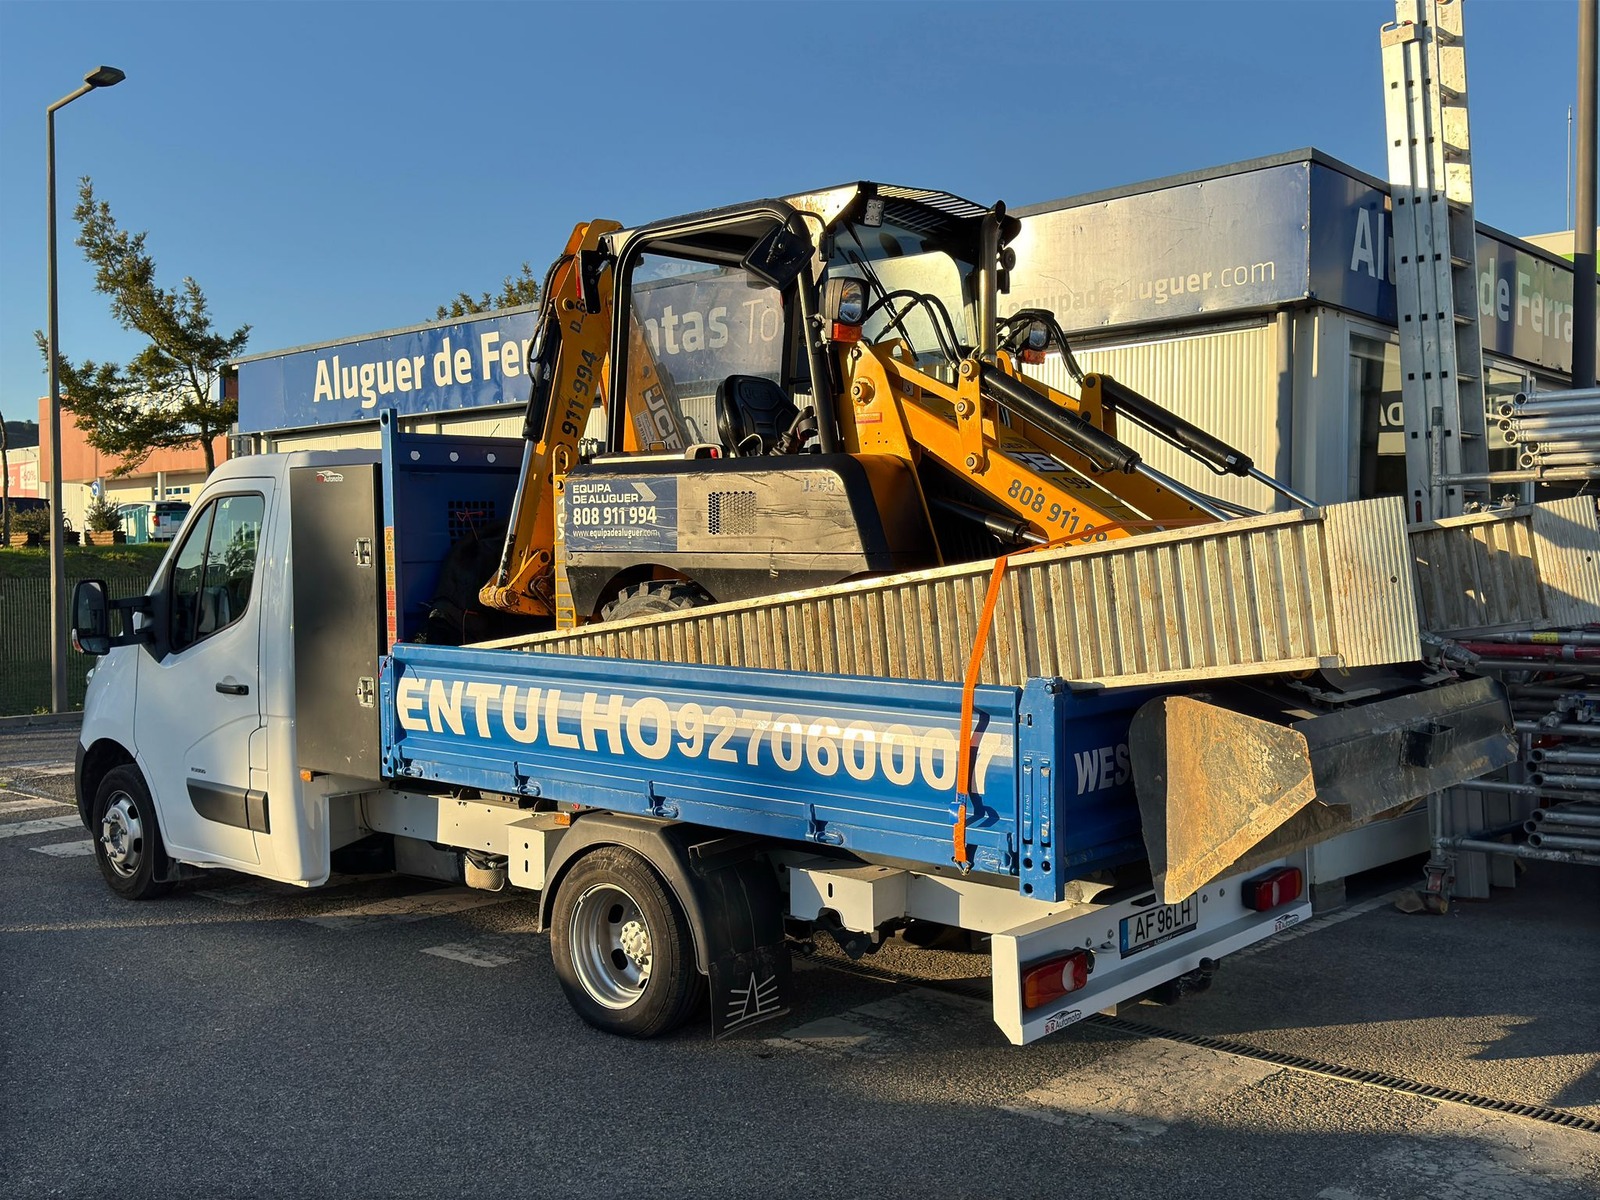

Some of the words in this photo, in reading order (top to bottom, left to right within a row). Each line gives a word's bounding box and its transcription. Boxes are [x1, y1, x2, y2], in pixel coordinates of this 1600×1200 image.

[1479, 258, 1510, 322] de
[313, 355, 425, 409] Aluguer
[433, 337, 472, 387] de
[572, 483, 611, 494] EQUIPA
[573, 507, 599, 525] 808
[603, 506, 626, 525] 911
[629, 505, 657, 525] 994
[1008, 479, 1046, 513] 808
[1046, 503, 1080, 535] 911
[572, 527, 657, 539] www.equipadealuguer.com
[396, 677, 672, 760] ENTULHO
[676, 703, 1001, 795] 927060007
[1074, 743, 1131, 795] WES
